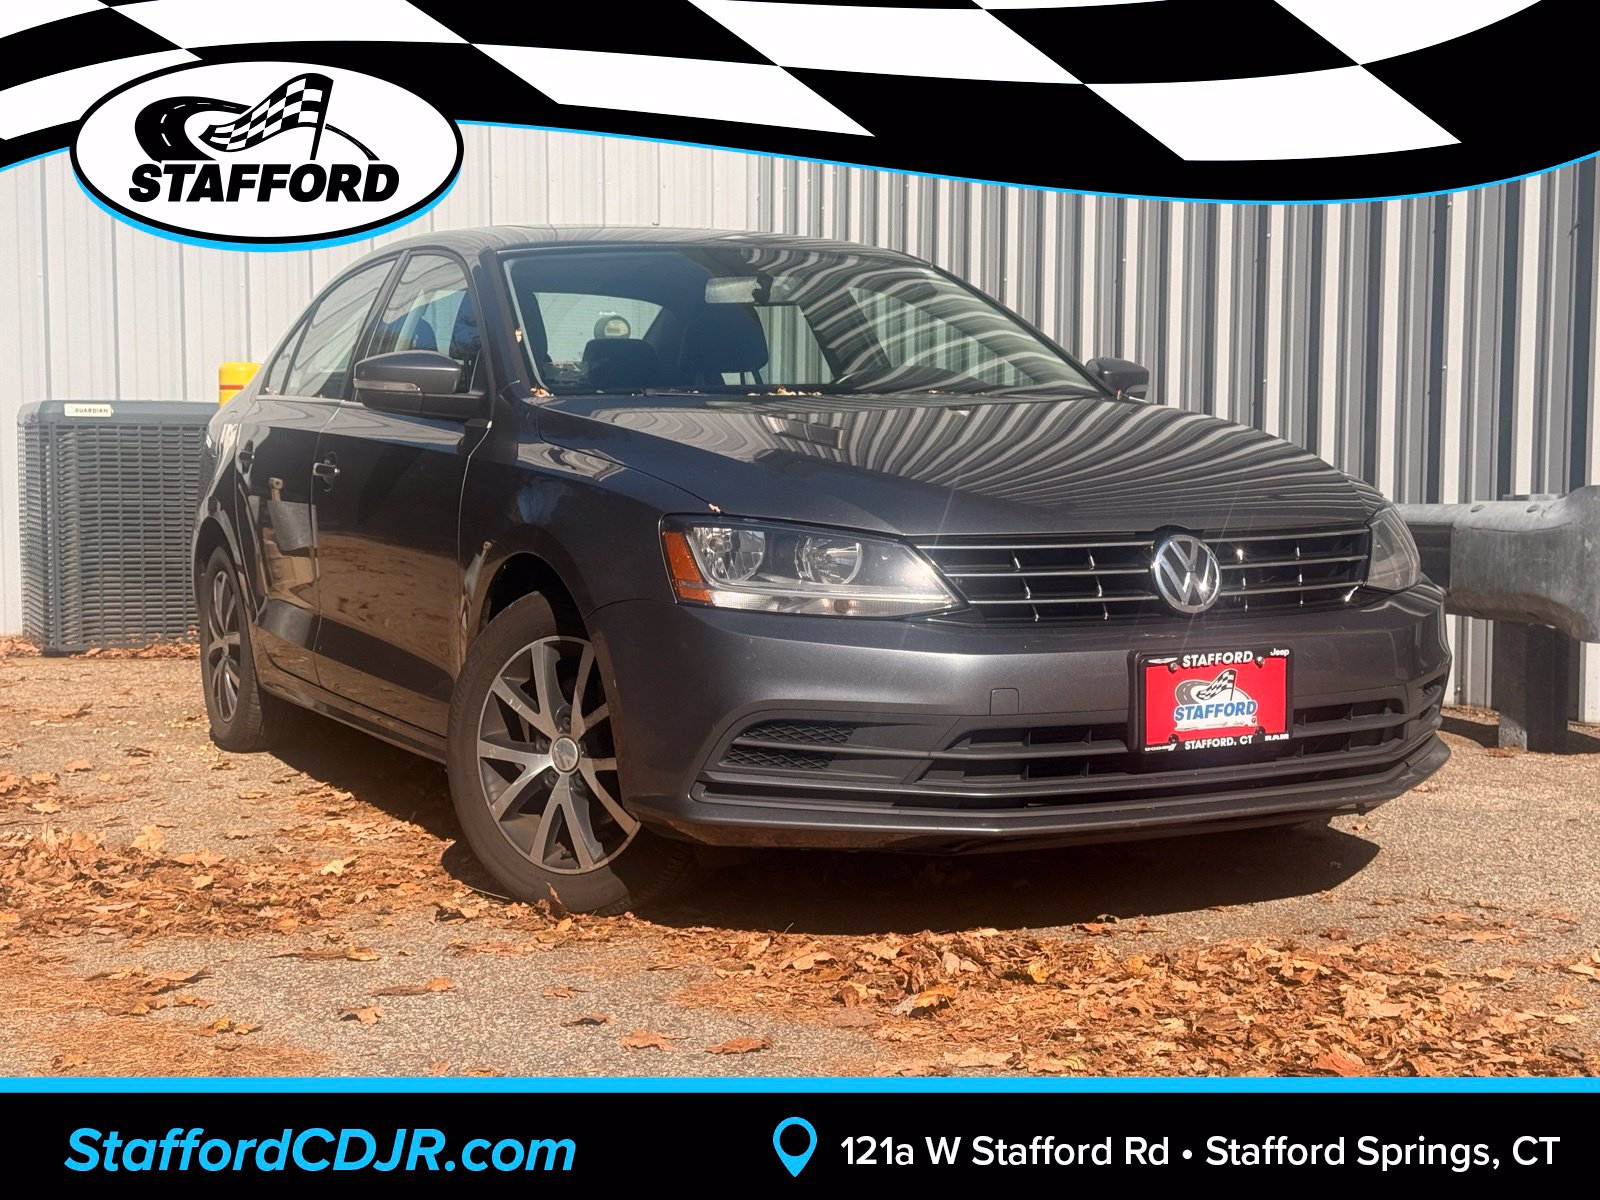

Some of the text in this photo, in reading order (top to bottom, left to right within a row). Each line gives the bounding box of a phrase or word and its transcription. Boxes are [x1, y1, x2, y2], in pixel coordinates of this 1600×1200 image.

[1270, 648, 1290, 657] Jeep
[1183, 651, 1254, 668] STAFFORD
[1175, 701, 1257, 722] STAFFORD
[1239, 735, 1253, 745] CT
[1265, 734, 1289, 742] RAM
